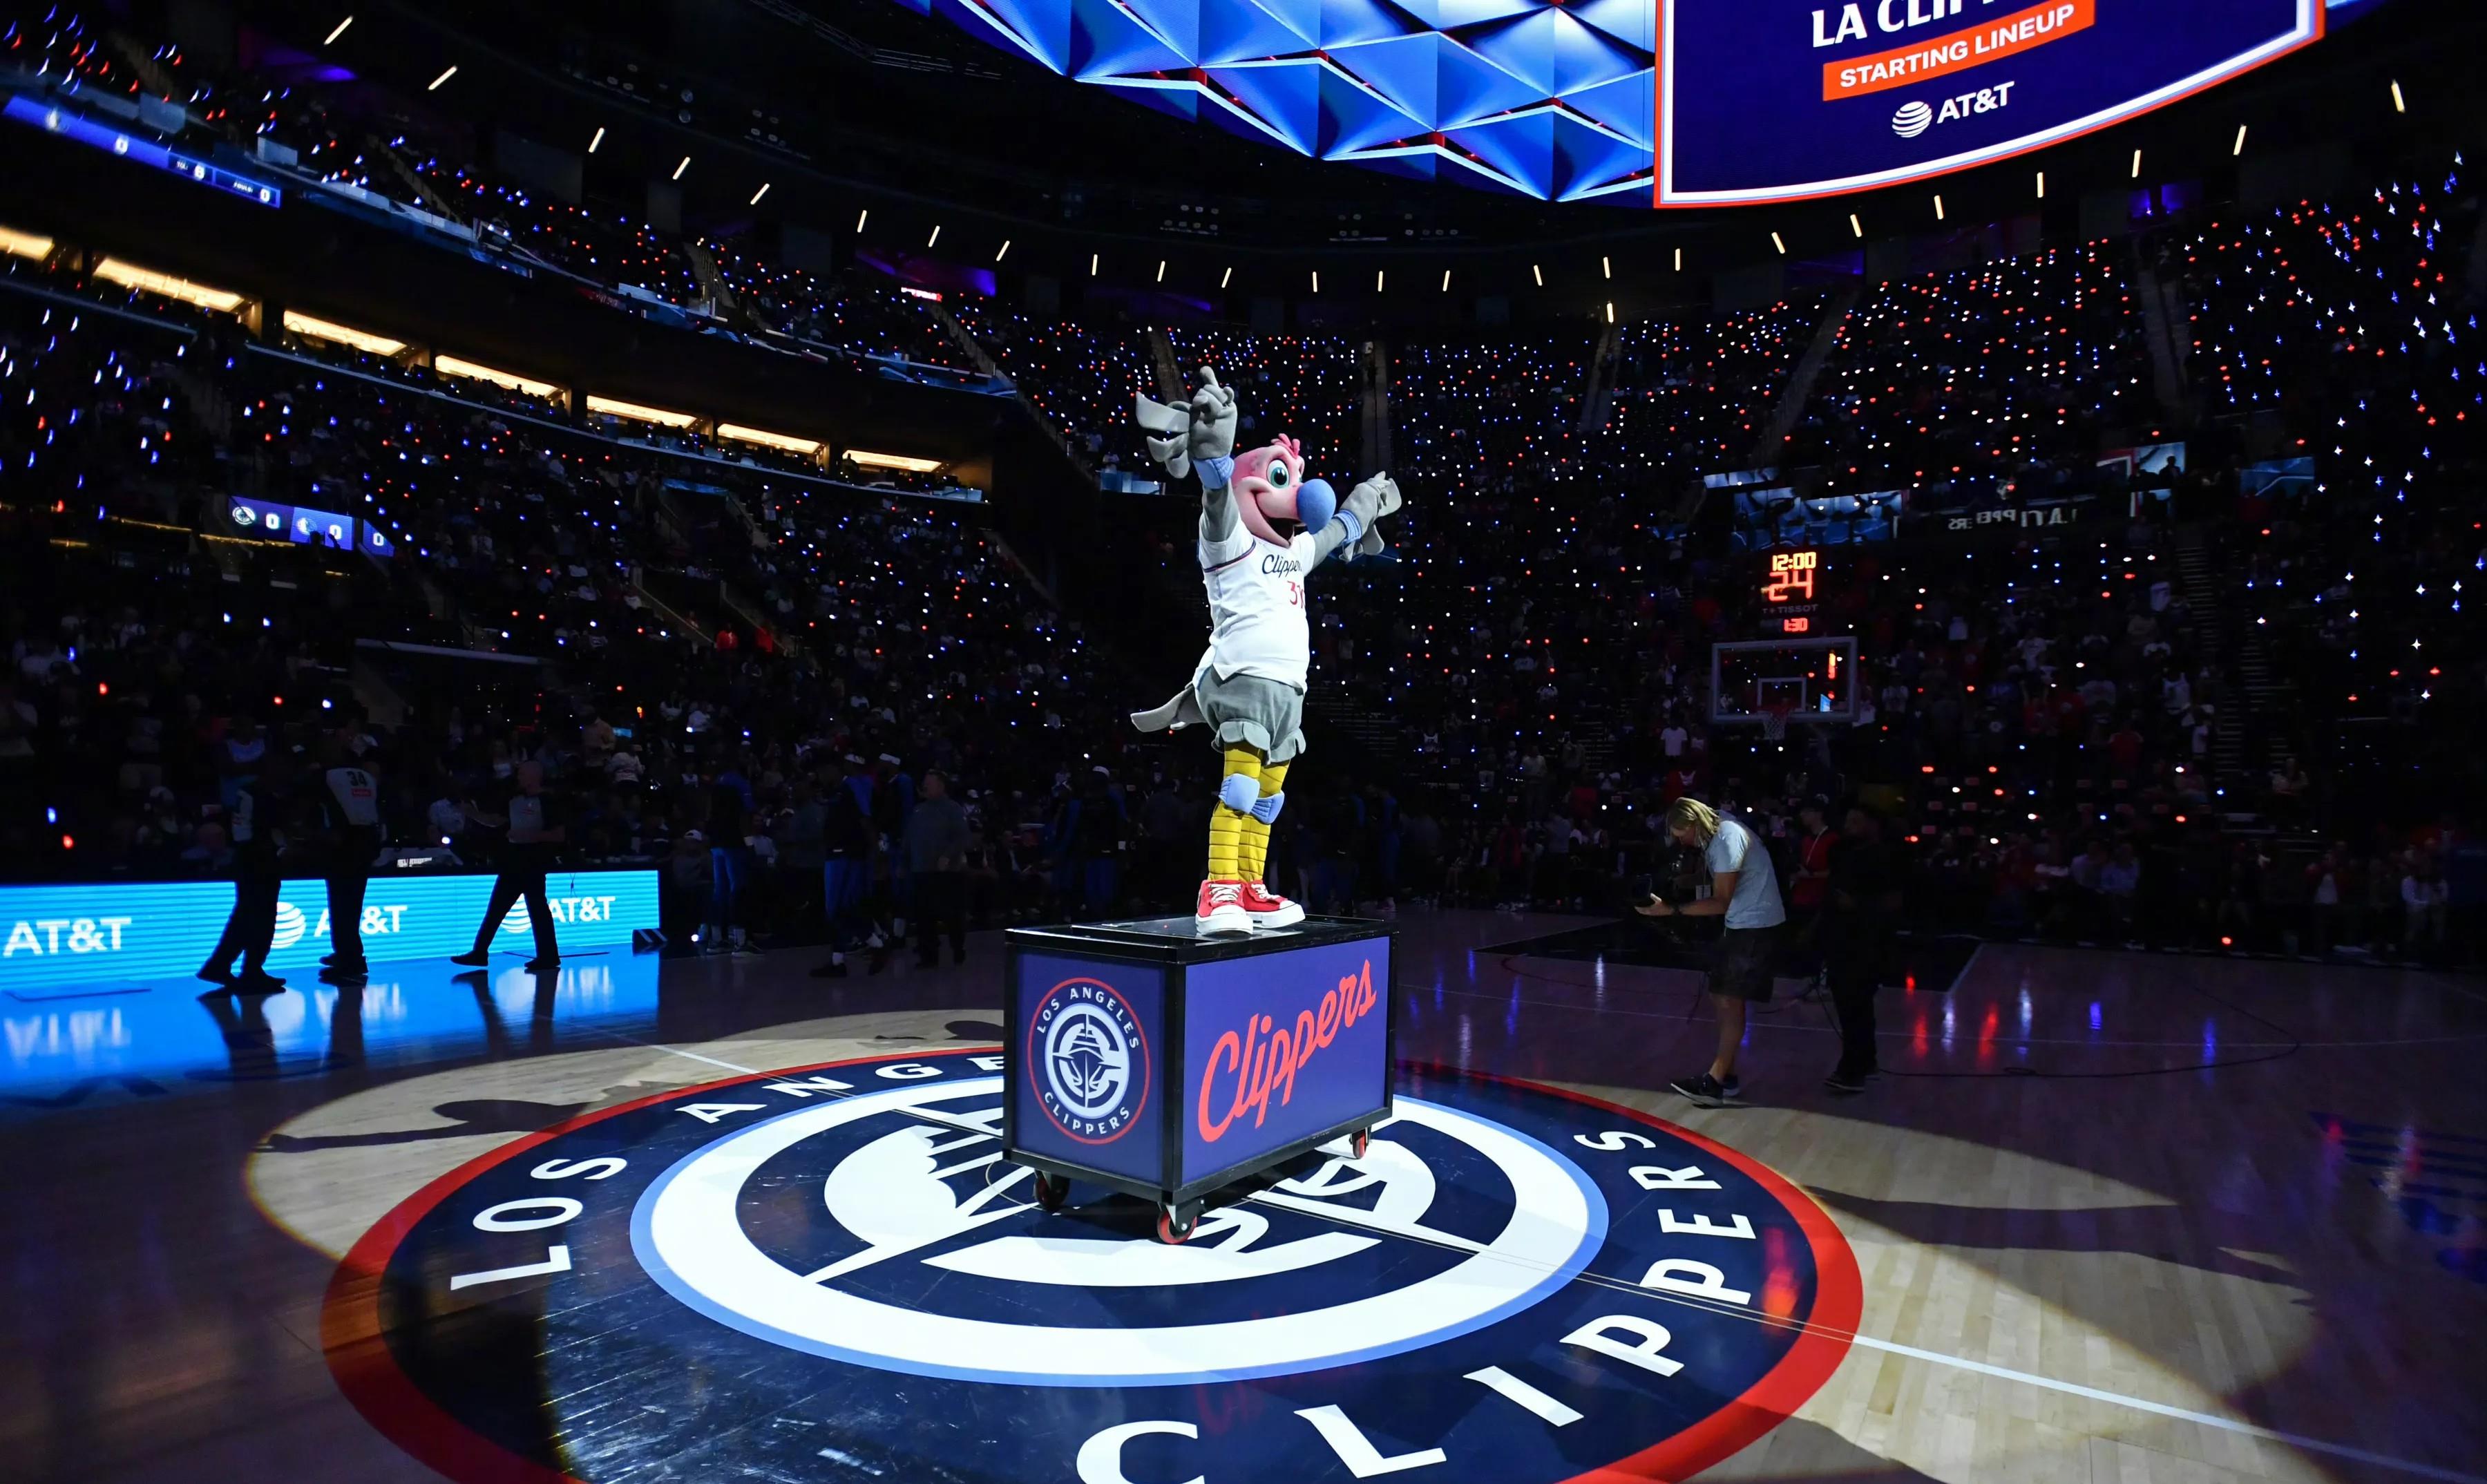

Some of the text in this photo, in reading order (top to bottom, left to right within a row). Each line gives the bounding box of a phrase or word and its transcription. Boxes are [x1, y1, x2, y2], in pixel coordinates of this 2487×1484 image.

[1812, 0, 1995, 48] LA CLI
[1840, 3, 2075, 88] STARTING LINEUP
[1936, 80, 2015, 124] AT&T
[265, 512, 280, 530] 0
[372, 532, 384, 546] 0
[1261, 554, 1302, 578] Clippe
[1772, 551, 1817, 571] 12:00
[1769, 569, 1813, 601] 24
[314, 904, 408, 938] A&T
[548, 896, 616, 923] AT&T
[3, 917, 131, 957] AT&T
[1037, 987, 1139, 1049] LOS ANGELES
[1199, 959, 1377, 1142] Clippers
[1045, 1092, 1130, 1134] CLIPPERS
[450, 1056, 1004, 1291] LOS ANGE
[1076, 1130, 1756, 1484] CLIPPERS
